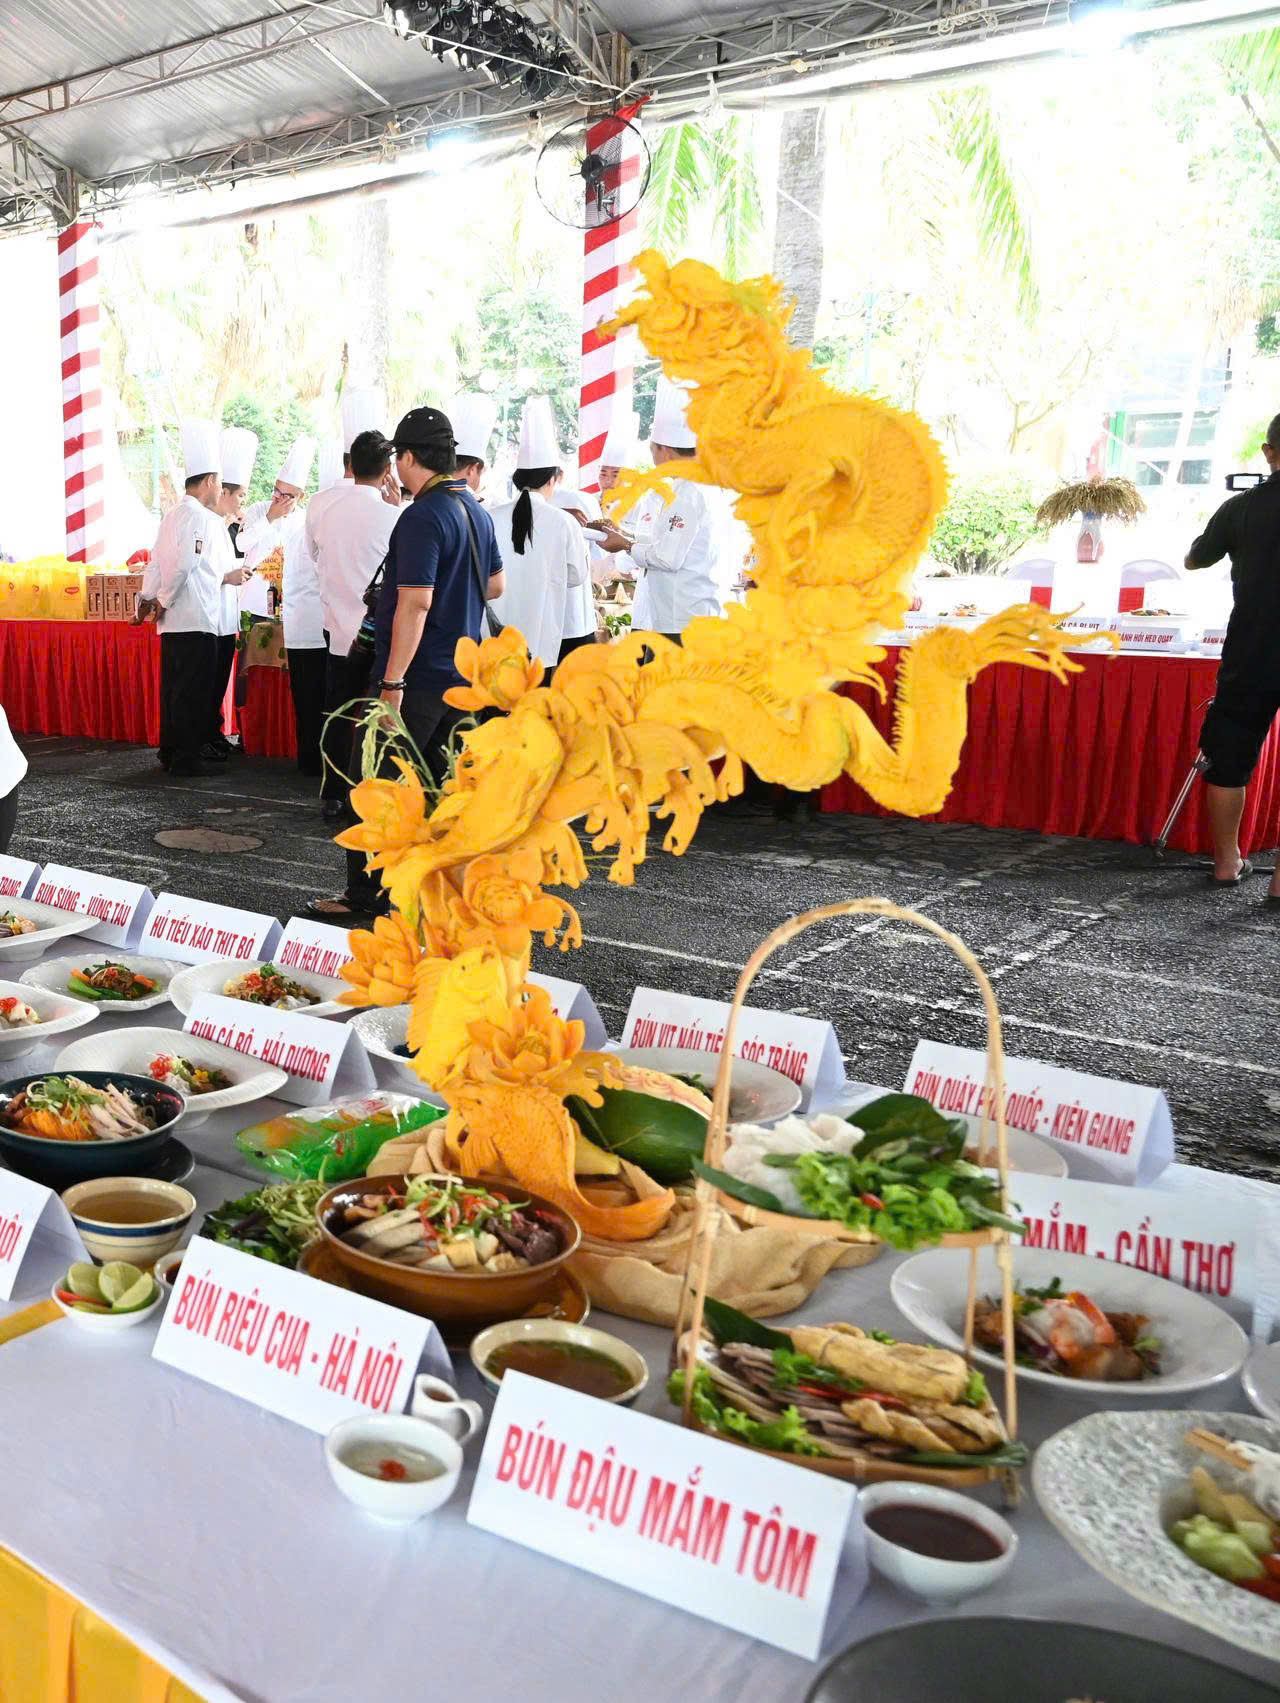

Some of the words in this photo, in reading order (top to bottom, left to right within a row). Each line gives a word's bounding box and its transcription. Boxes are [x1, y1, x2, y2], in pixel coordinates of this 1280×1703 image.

[35, 880, 58, 906] BÚN
[54, 885, 81, 912] SÚNG
[86, 893, 114, 923] VŨNG
[110, 895, 131, 927] TÀU
[149, 909, 170, 938] HỦ
[166, 914, 192, 944] TIẾU
[189, 922, 213, 951] XÀO
[211, 930, 239, 960] THỊT
[235, 933, 256, 960] BÒ
[280, 937, 299, 965] BÚN
[298, 939, 323, 974] HẾN
[283, 1044, 330, 1083] DƯƠNG
[630, 1013, 657, 1048] BÚN
[767, 1044, 808, 1086] TRĂNG
[912, 1066, 940, 1105] BÚN
[1005, 1086, 1045, 1132] QUỐC
[1050, 1100, 1090, 1143] KIÊN
[1086, 1112, 1136, 1155] GIANG
[1021, 1201, 1088, 1255] MẮM
[1115, 1216, 1172, 1280] CẦN
[1182, 1241, 1236, 1297] THƠ
[173, 1269, 222, 1337] BÚN
[214, 1288, 270, 1356] RIÊU
[264, 1311, 310, 1376] CUA
[320, 1326, 360, 1396] HÀ
[496, 1420, 567, 1501] BÚN
[566, 1445, 638, 1533] ĐẬU
[638, 1466, 731, 1566] MẮM
[735, 1505, 818, 1600] TÔM
